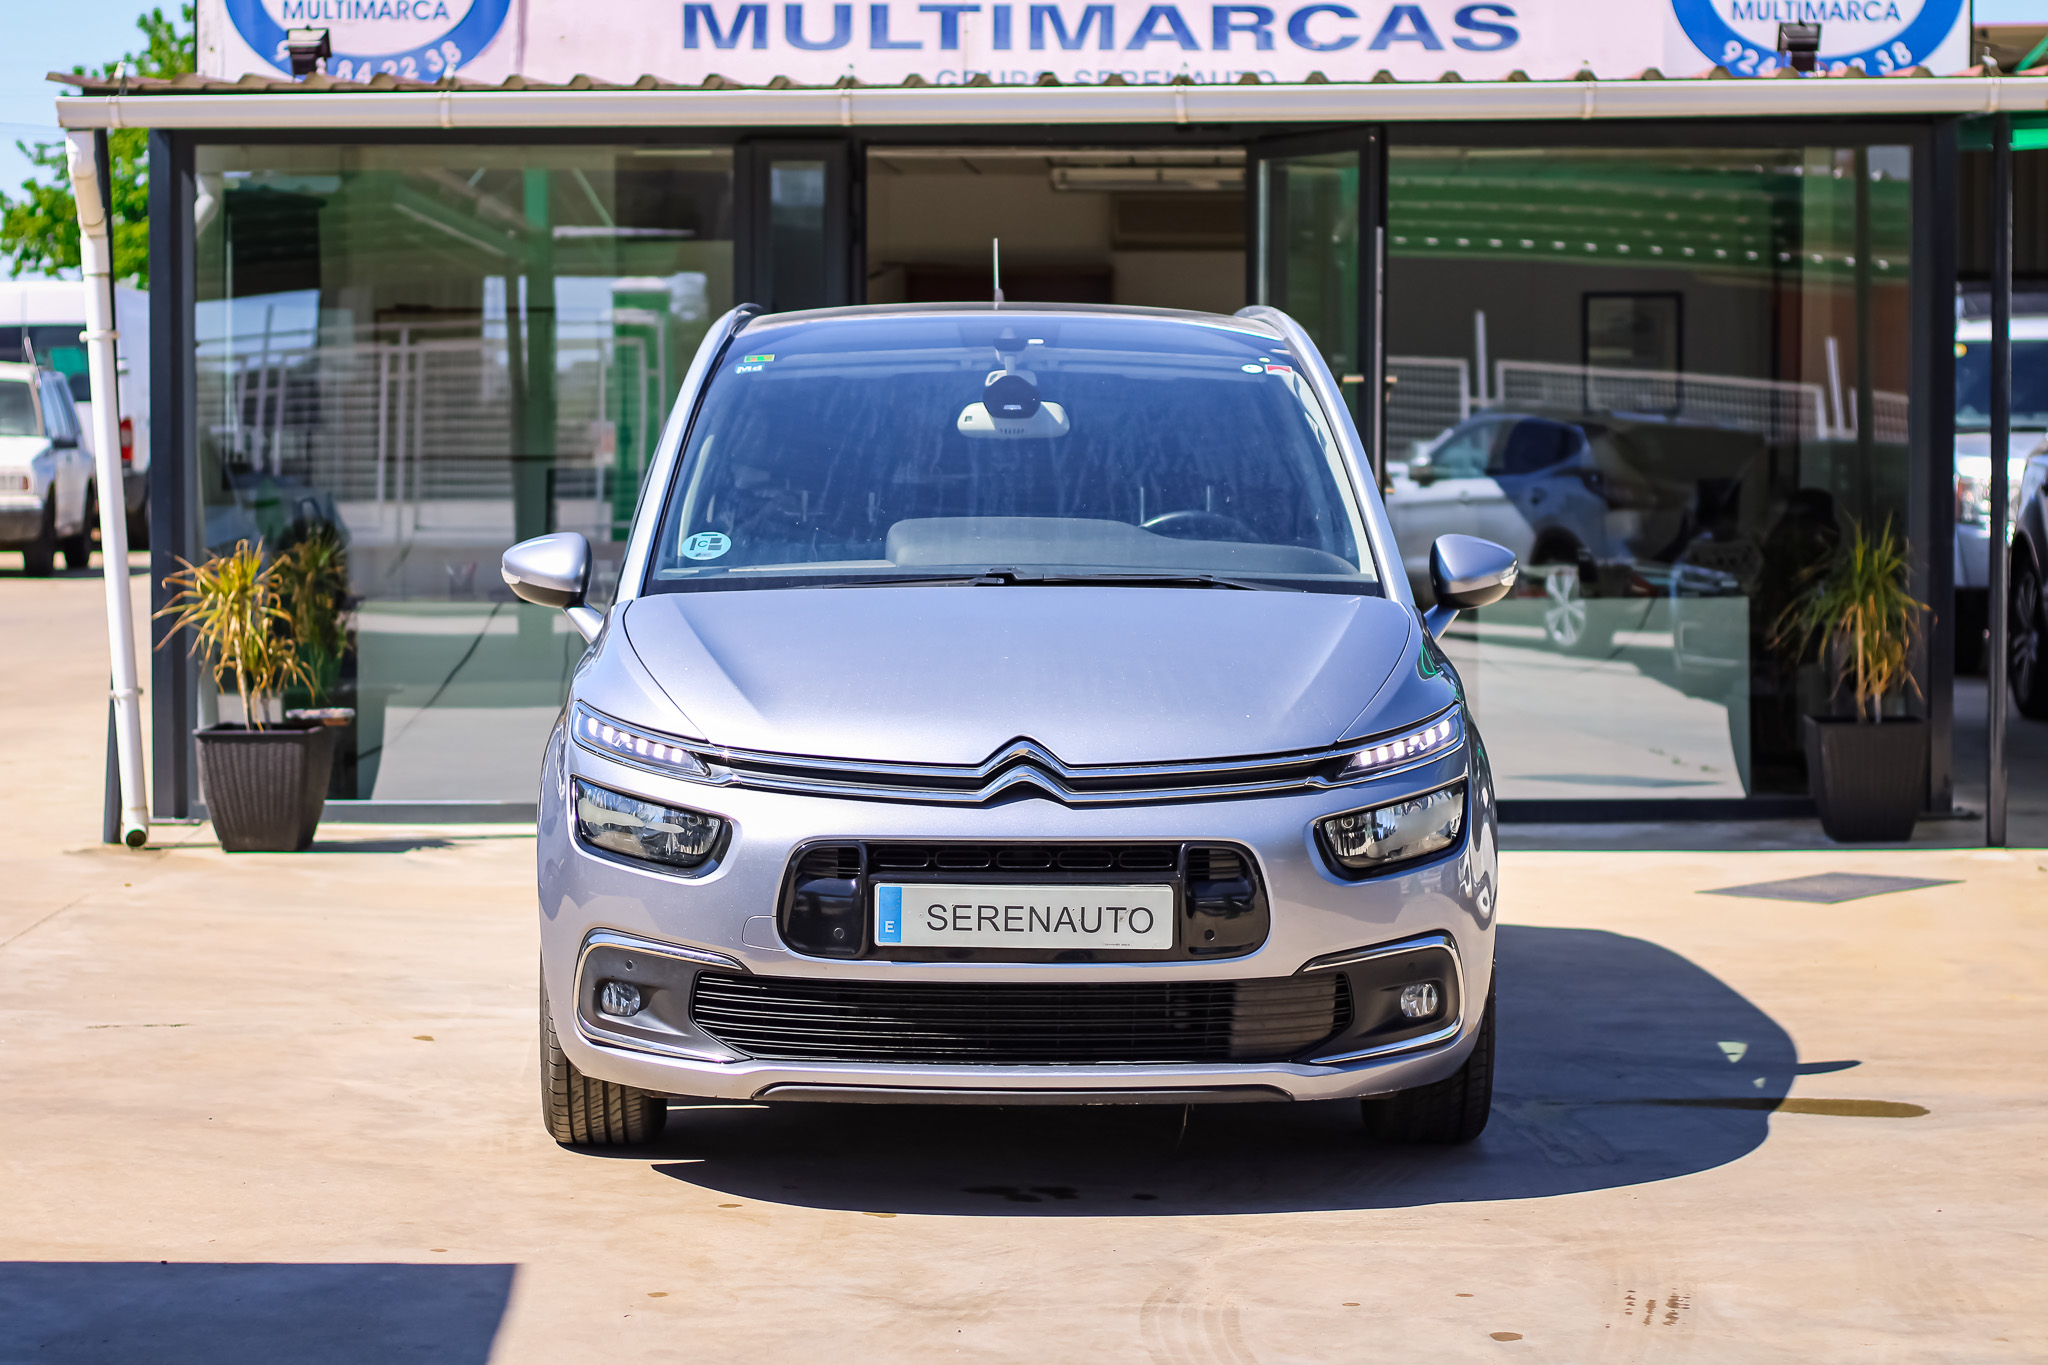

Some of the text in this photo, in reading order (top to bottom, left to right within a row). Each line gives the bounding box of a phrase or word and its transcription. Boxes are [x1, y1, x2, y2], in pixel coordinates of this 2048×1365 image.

[283, 0, 450, 20] MULTIMARCA
[1732, 0, 1901, 21] MULTIMARCA
[682, 3, 1521, 52] MULTIMARCAS
[425, 40, 463, 73] 38
[1722, 40, 1778, 75] 924
[1874, 41, 1912, 75] 38
[885, 904, 1154, 933] E SERENAUTO
